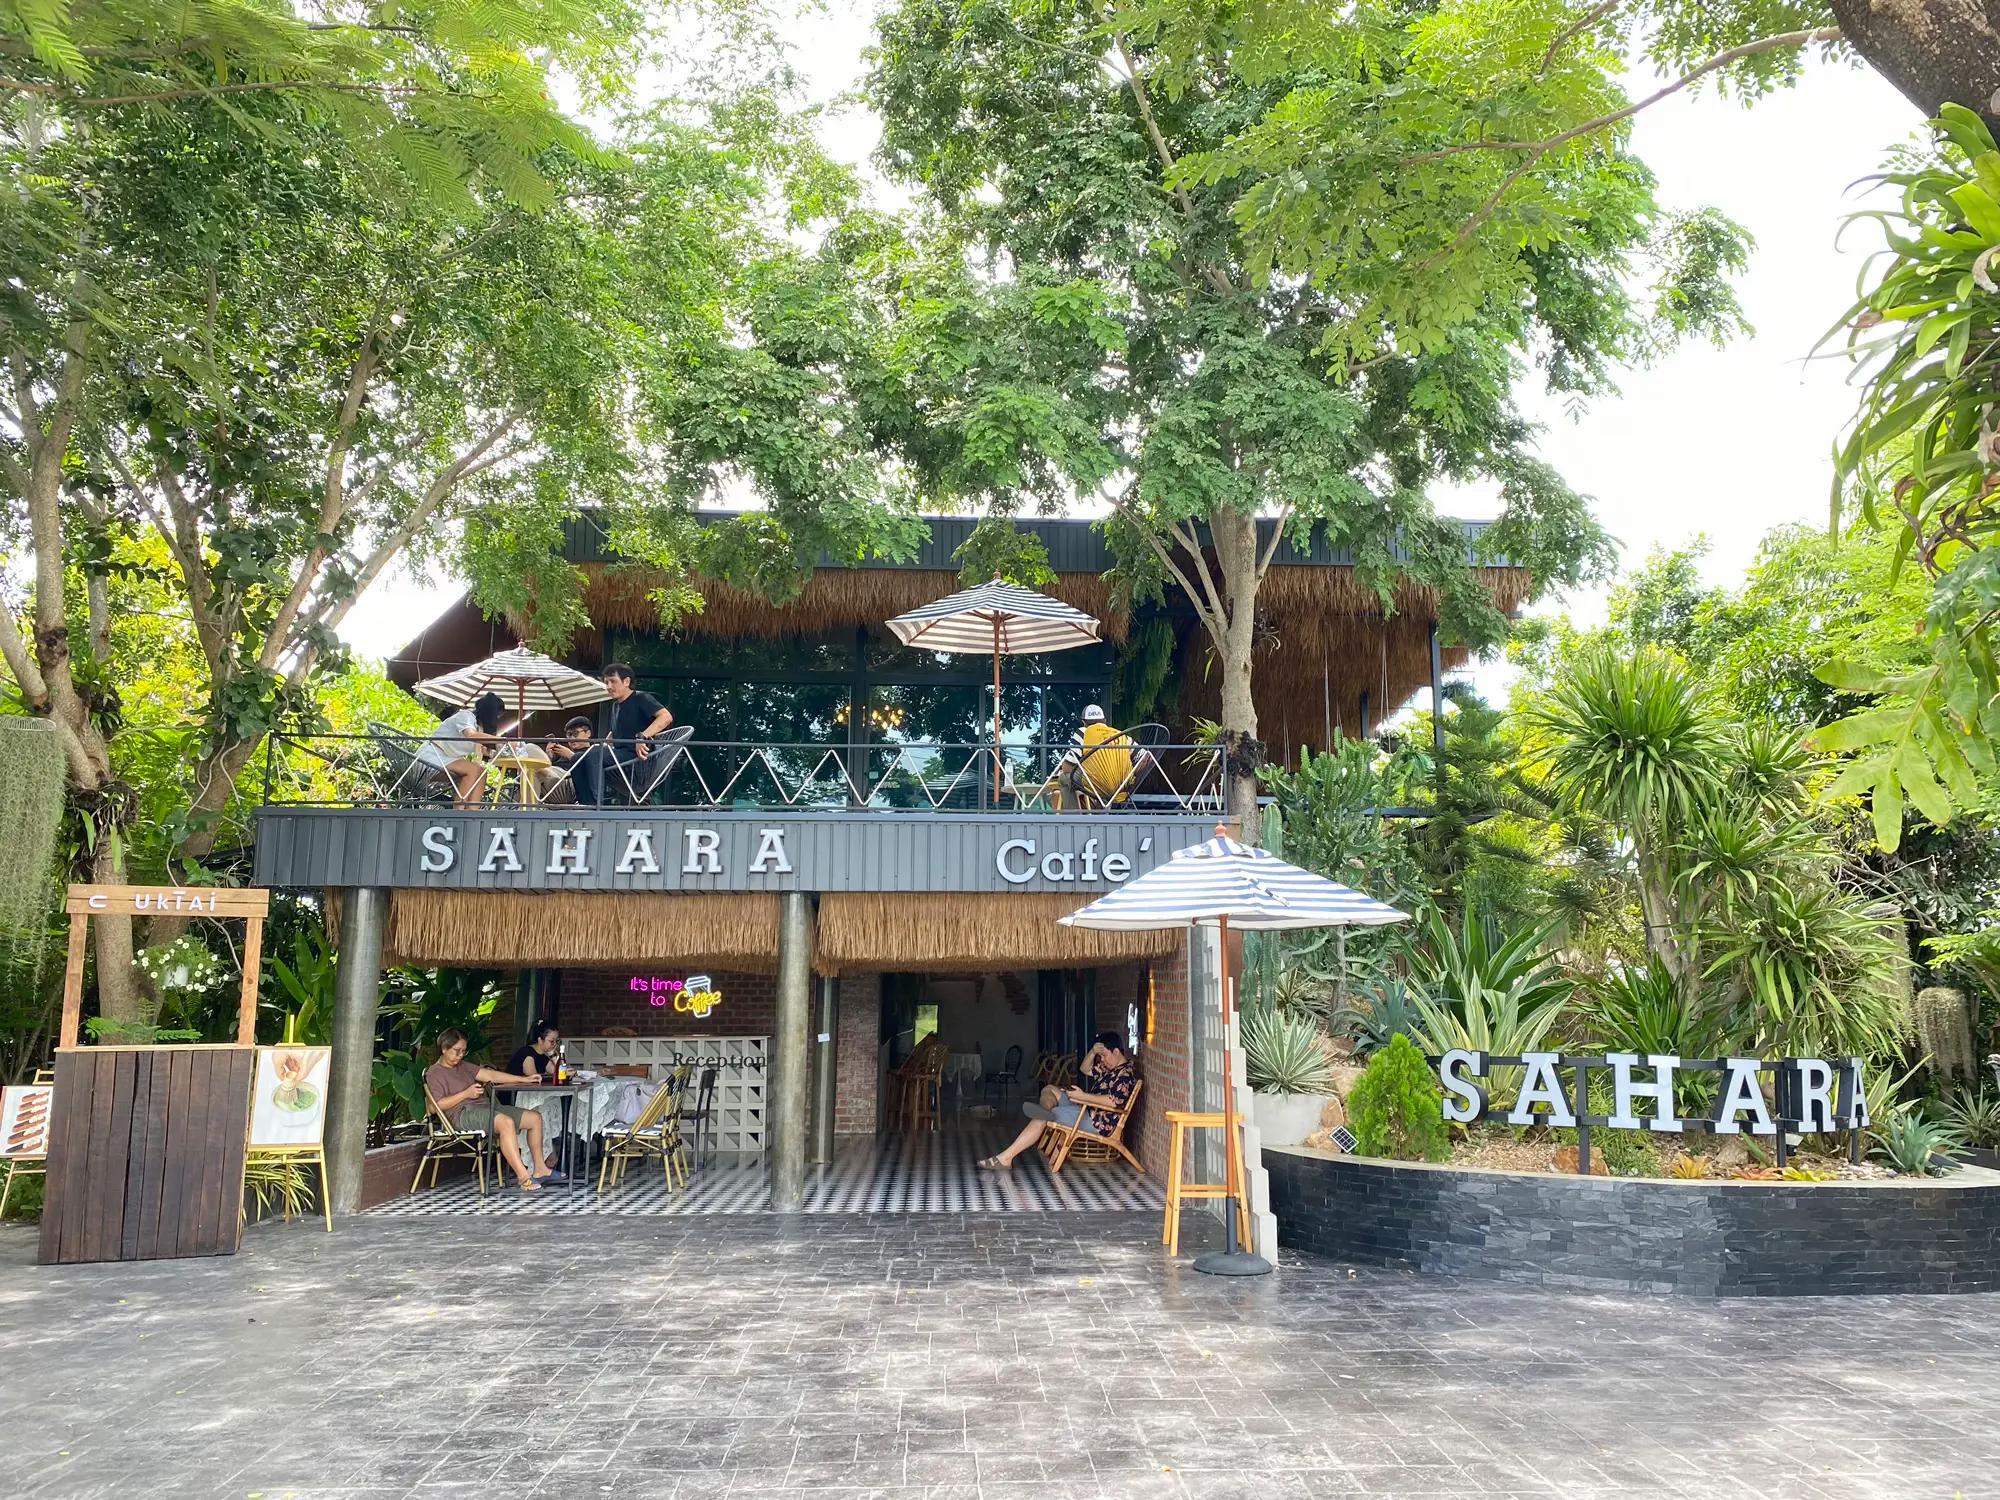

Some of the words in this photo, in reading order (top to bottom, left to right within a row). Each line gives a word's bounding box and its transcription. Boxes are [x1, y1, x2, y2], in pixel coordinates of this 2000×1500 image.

[421, 826, 792, 874] SAHARA
[630, 976, 648, 991] It's
[651, 976, 683, 991] time
[650, 992, 666, 1006] to
[674, 990, 722, 1012] Coffee
[672, 1052, 767, 1071] Reception
[1439, 1048, 1869, 1134] SAHARA
